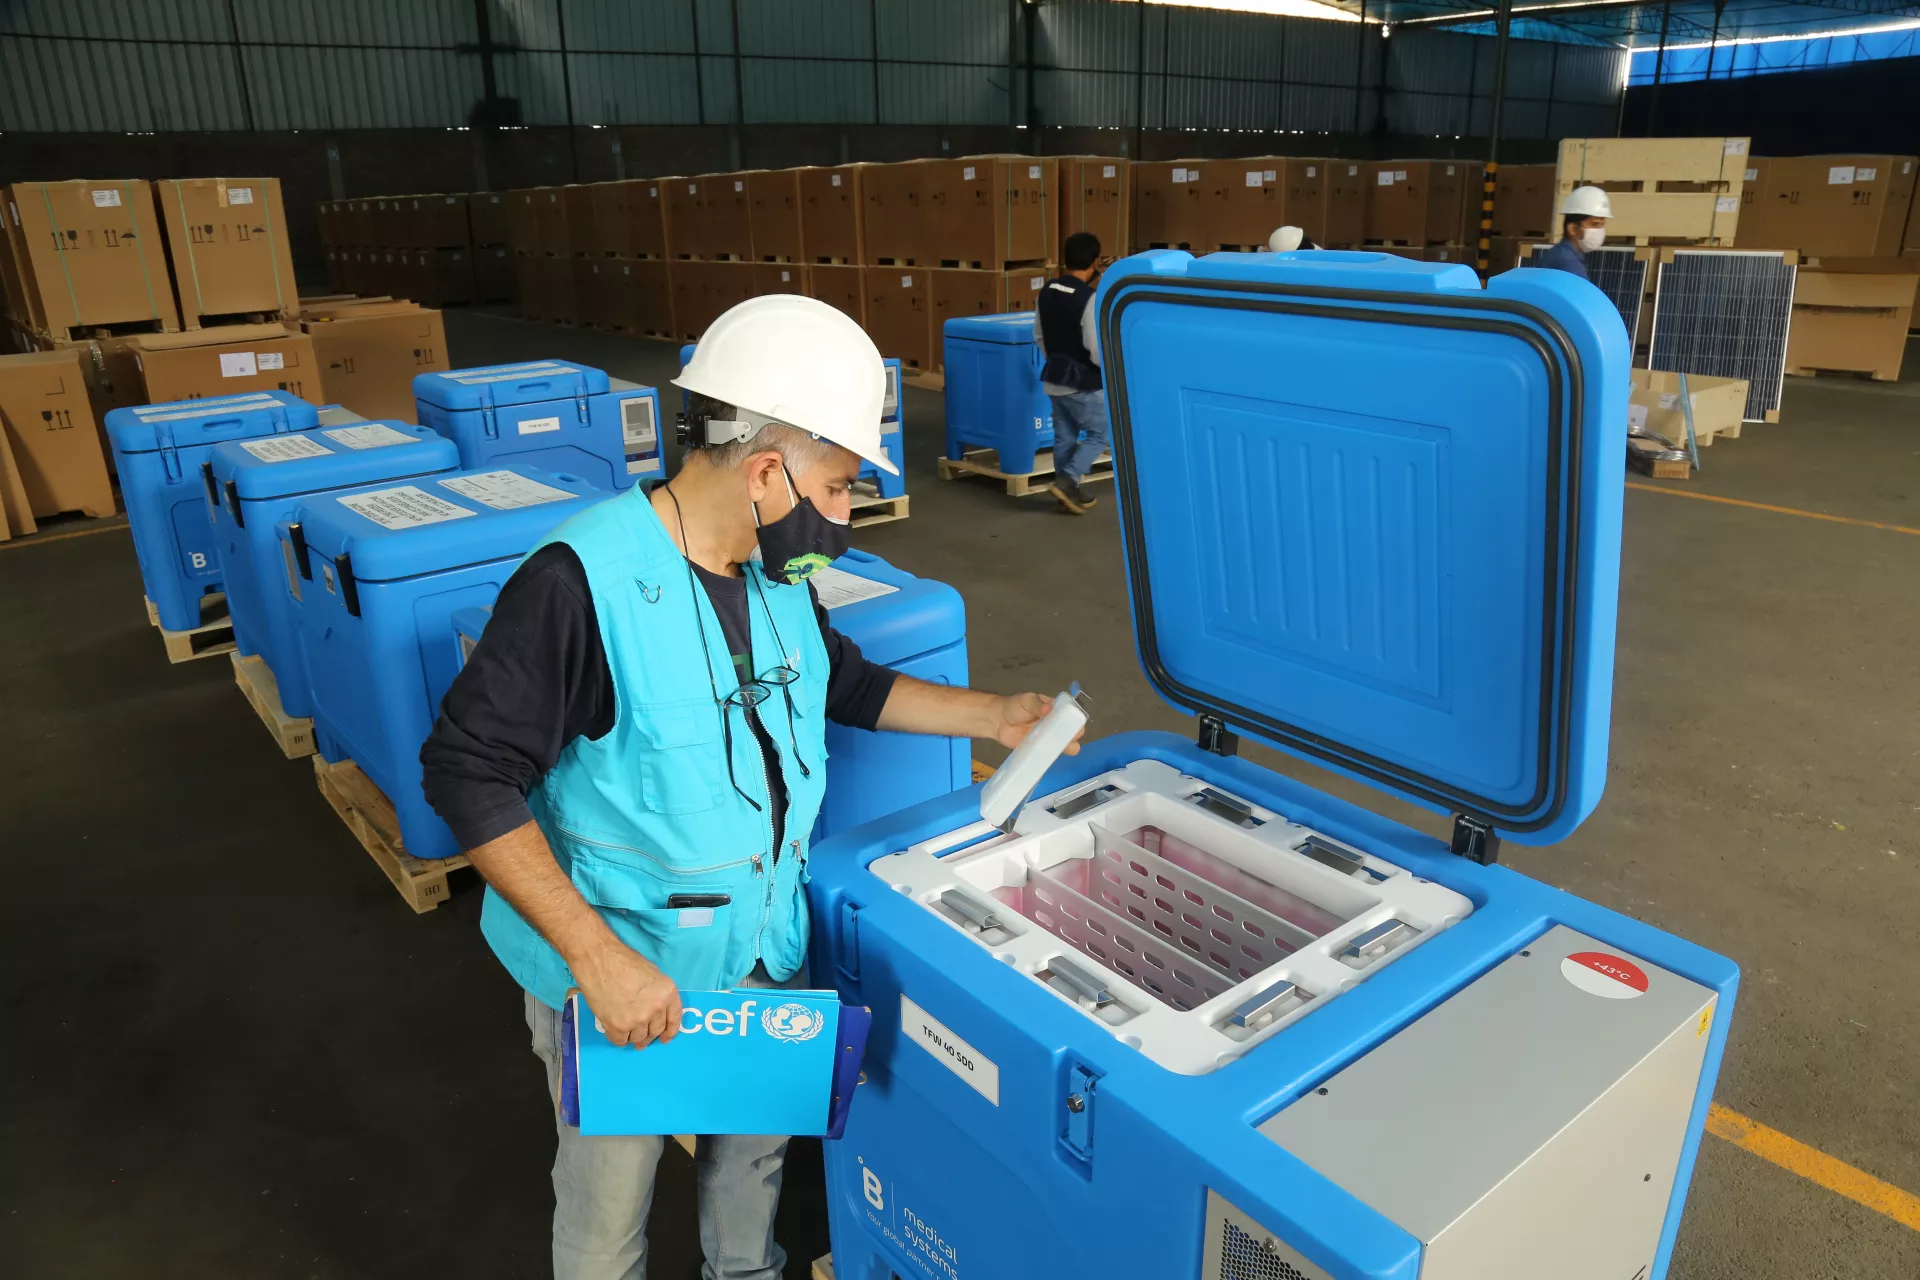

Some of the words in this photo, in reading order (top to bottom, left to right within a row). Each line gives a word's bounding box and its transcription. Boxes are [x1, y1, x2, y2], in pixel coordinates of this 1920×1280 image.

[1592, 960, 1631, 980] +43°C
[922, 1024, 942, 1046] TFW
[943, 1042, 955, 1057] 40
[956, 1051, 974, 1072] SDD
[866, 1208, 881, 1228] Your
[883, 1226, 905, 1251] global
[906, 1249, 934, 1277] partner
[904, 1207, 958, 1265] medical
[904, 1225, 958, 1280] systems
